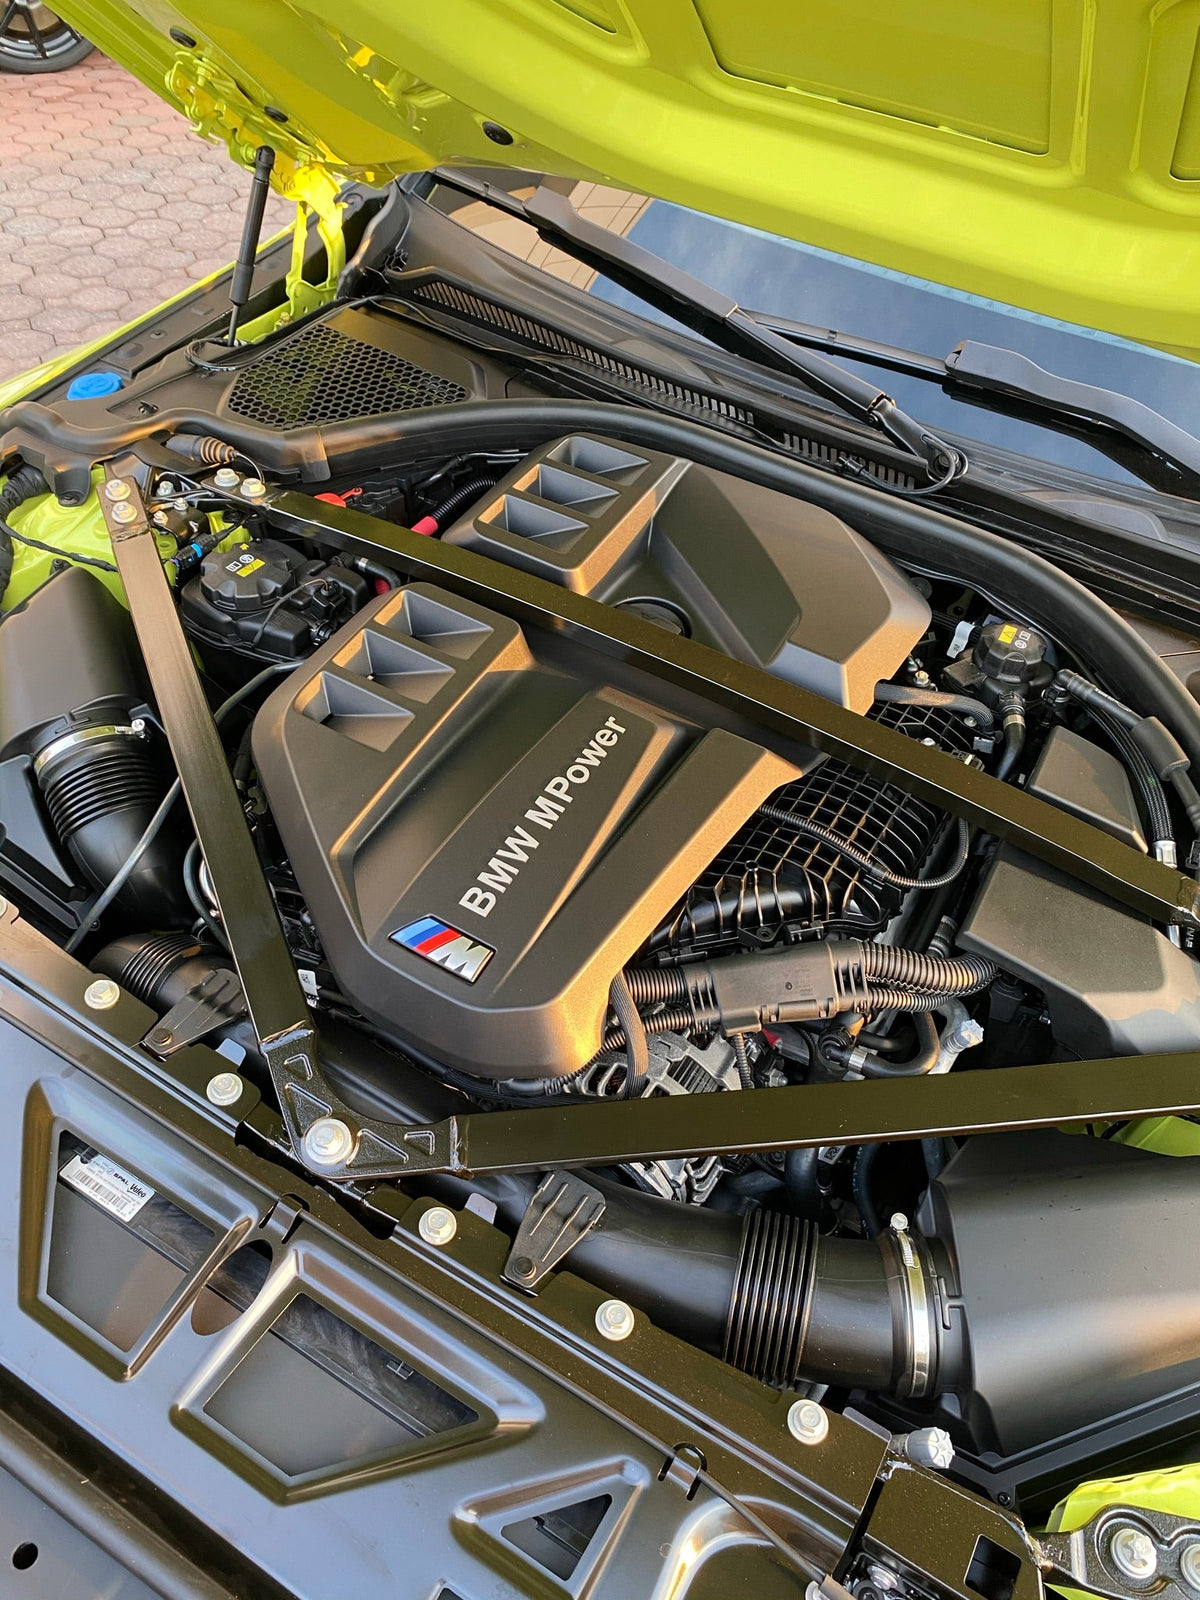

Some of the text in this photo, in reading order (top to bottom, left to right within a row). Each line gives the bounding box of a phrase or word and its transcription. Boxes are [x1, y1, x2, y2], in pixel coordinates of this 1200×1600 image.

[458, 716, 627, 918] BMW MPower
[113, 1172, 129, 1186] SPAL
[129, 1183, 147, 1199] Valeo
